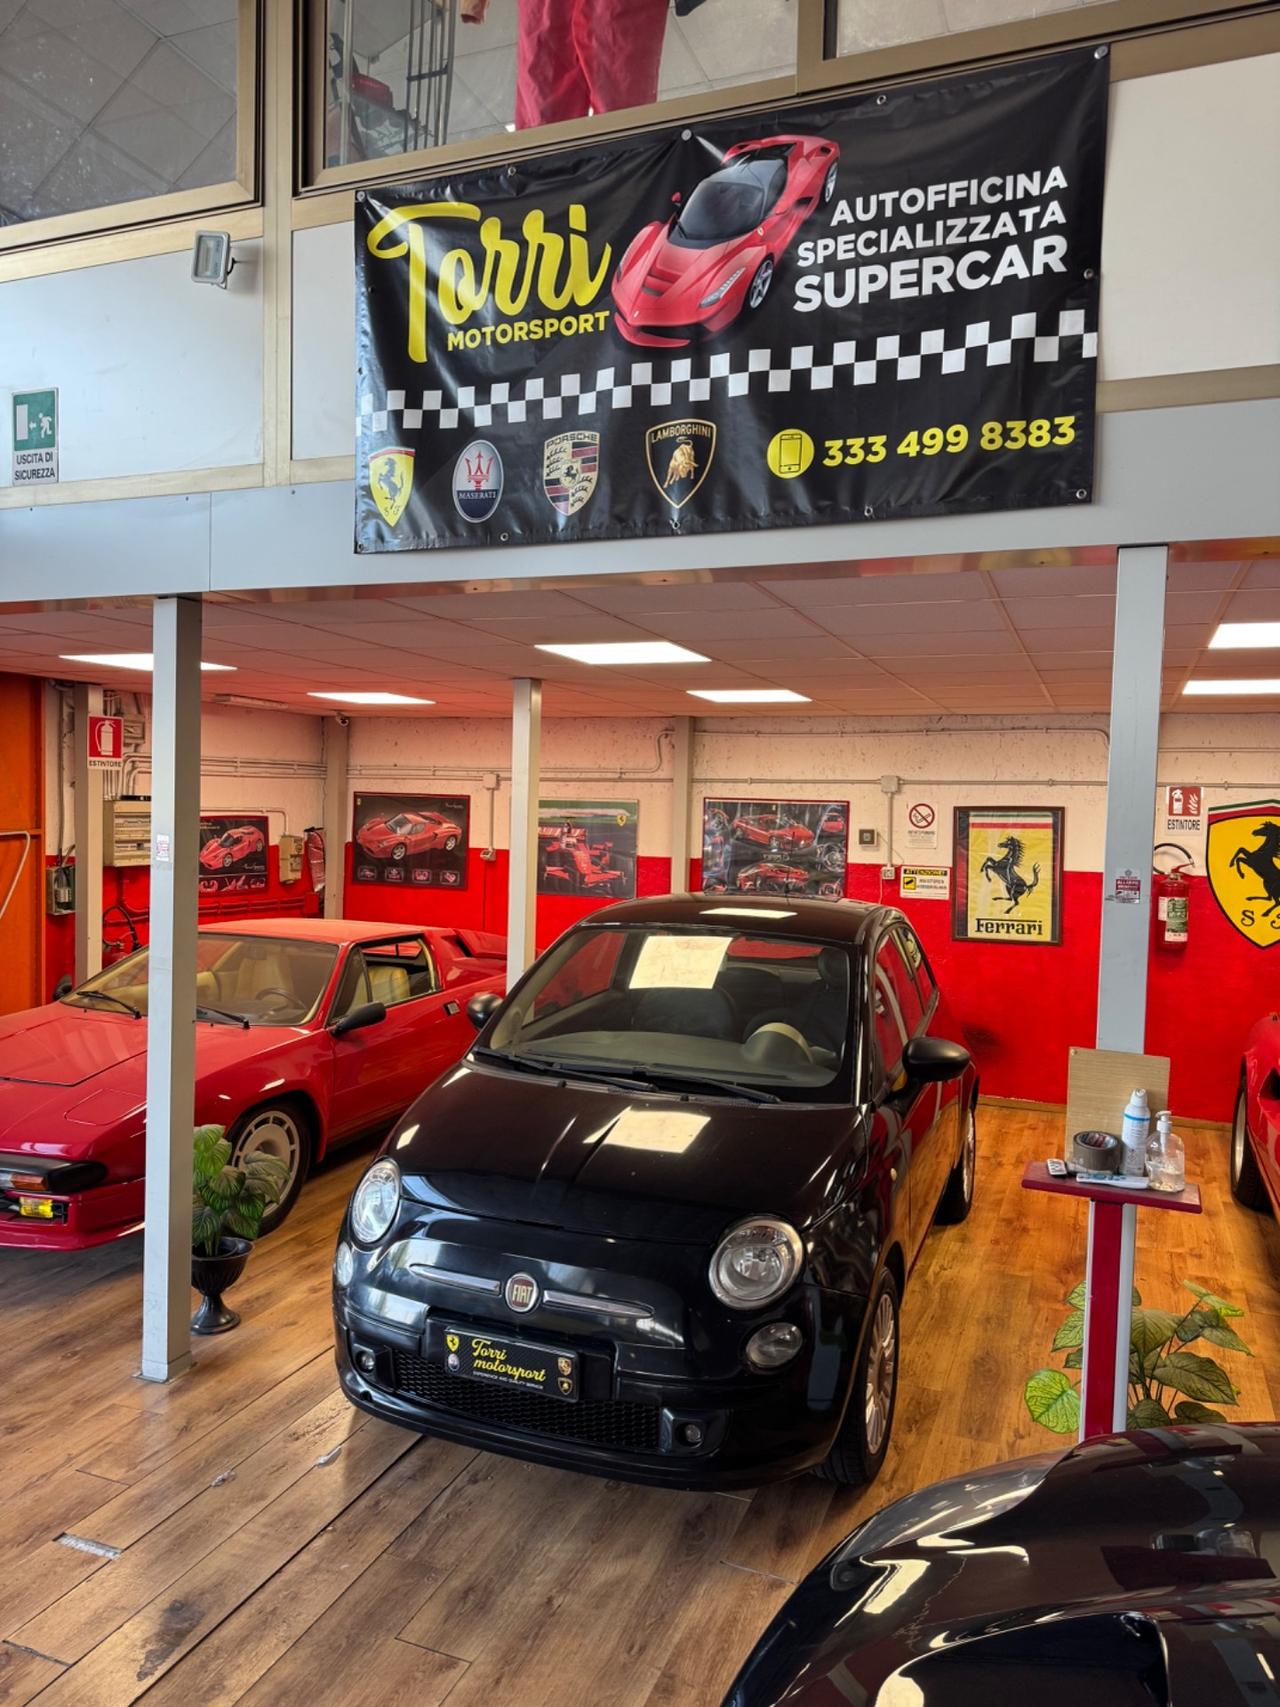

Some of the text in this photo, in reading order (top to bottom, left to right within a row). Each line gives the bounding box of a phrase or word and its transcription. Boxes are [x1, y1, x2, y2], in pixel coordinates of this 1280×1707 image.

[830, 166, 1068, 227] AUTOFFICINA
[797, 200, 1067, 267] SPECIALIZZATA
[366, 201, 612, 363] Torri
[793, 234, 1068, 312] SUPERCAR
[447, 311, 610, 351] MOTORSPORT
[546, 432, 598, 449] PORSCHE
[651, 424, 712, 443] LAMBORGHINI
[822, 416, 1077, 467] 333 499 8383
[16, 452, 53, 465] USCITA DI
[14, 467, 55, 480] SICUREZZA
[459, 491, 496, 500] MASERATI
[89, 760, 122, 768] ESTINTORE
[1167, 819, 1200, 831] ESTINTORE
[974, 917, 1043, 936] Ferrari
[512, 1284, 533, 1304] FIAT
[471, 1338, 507, 1360] Torri
[473, 1358, 546, 1382] motorsport
